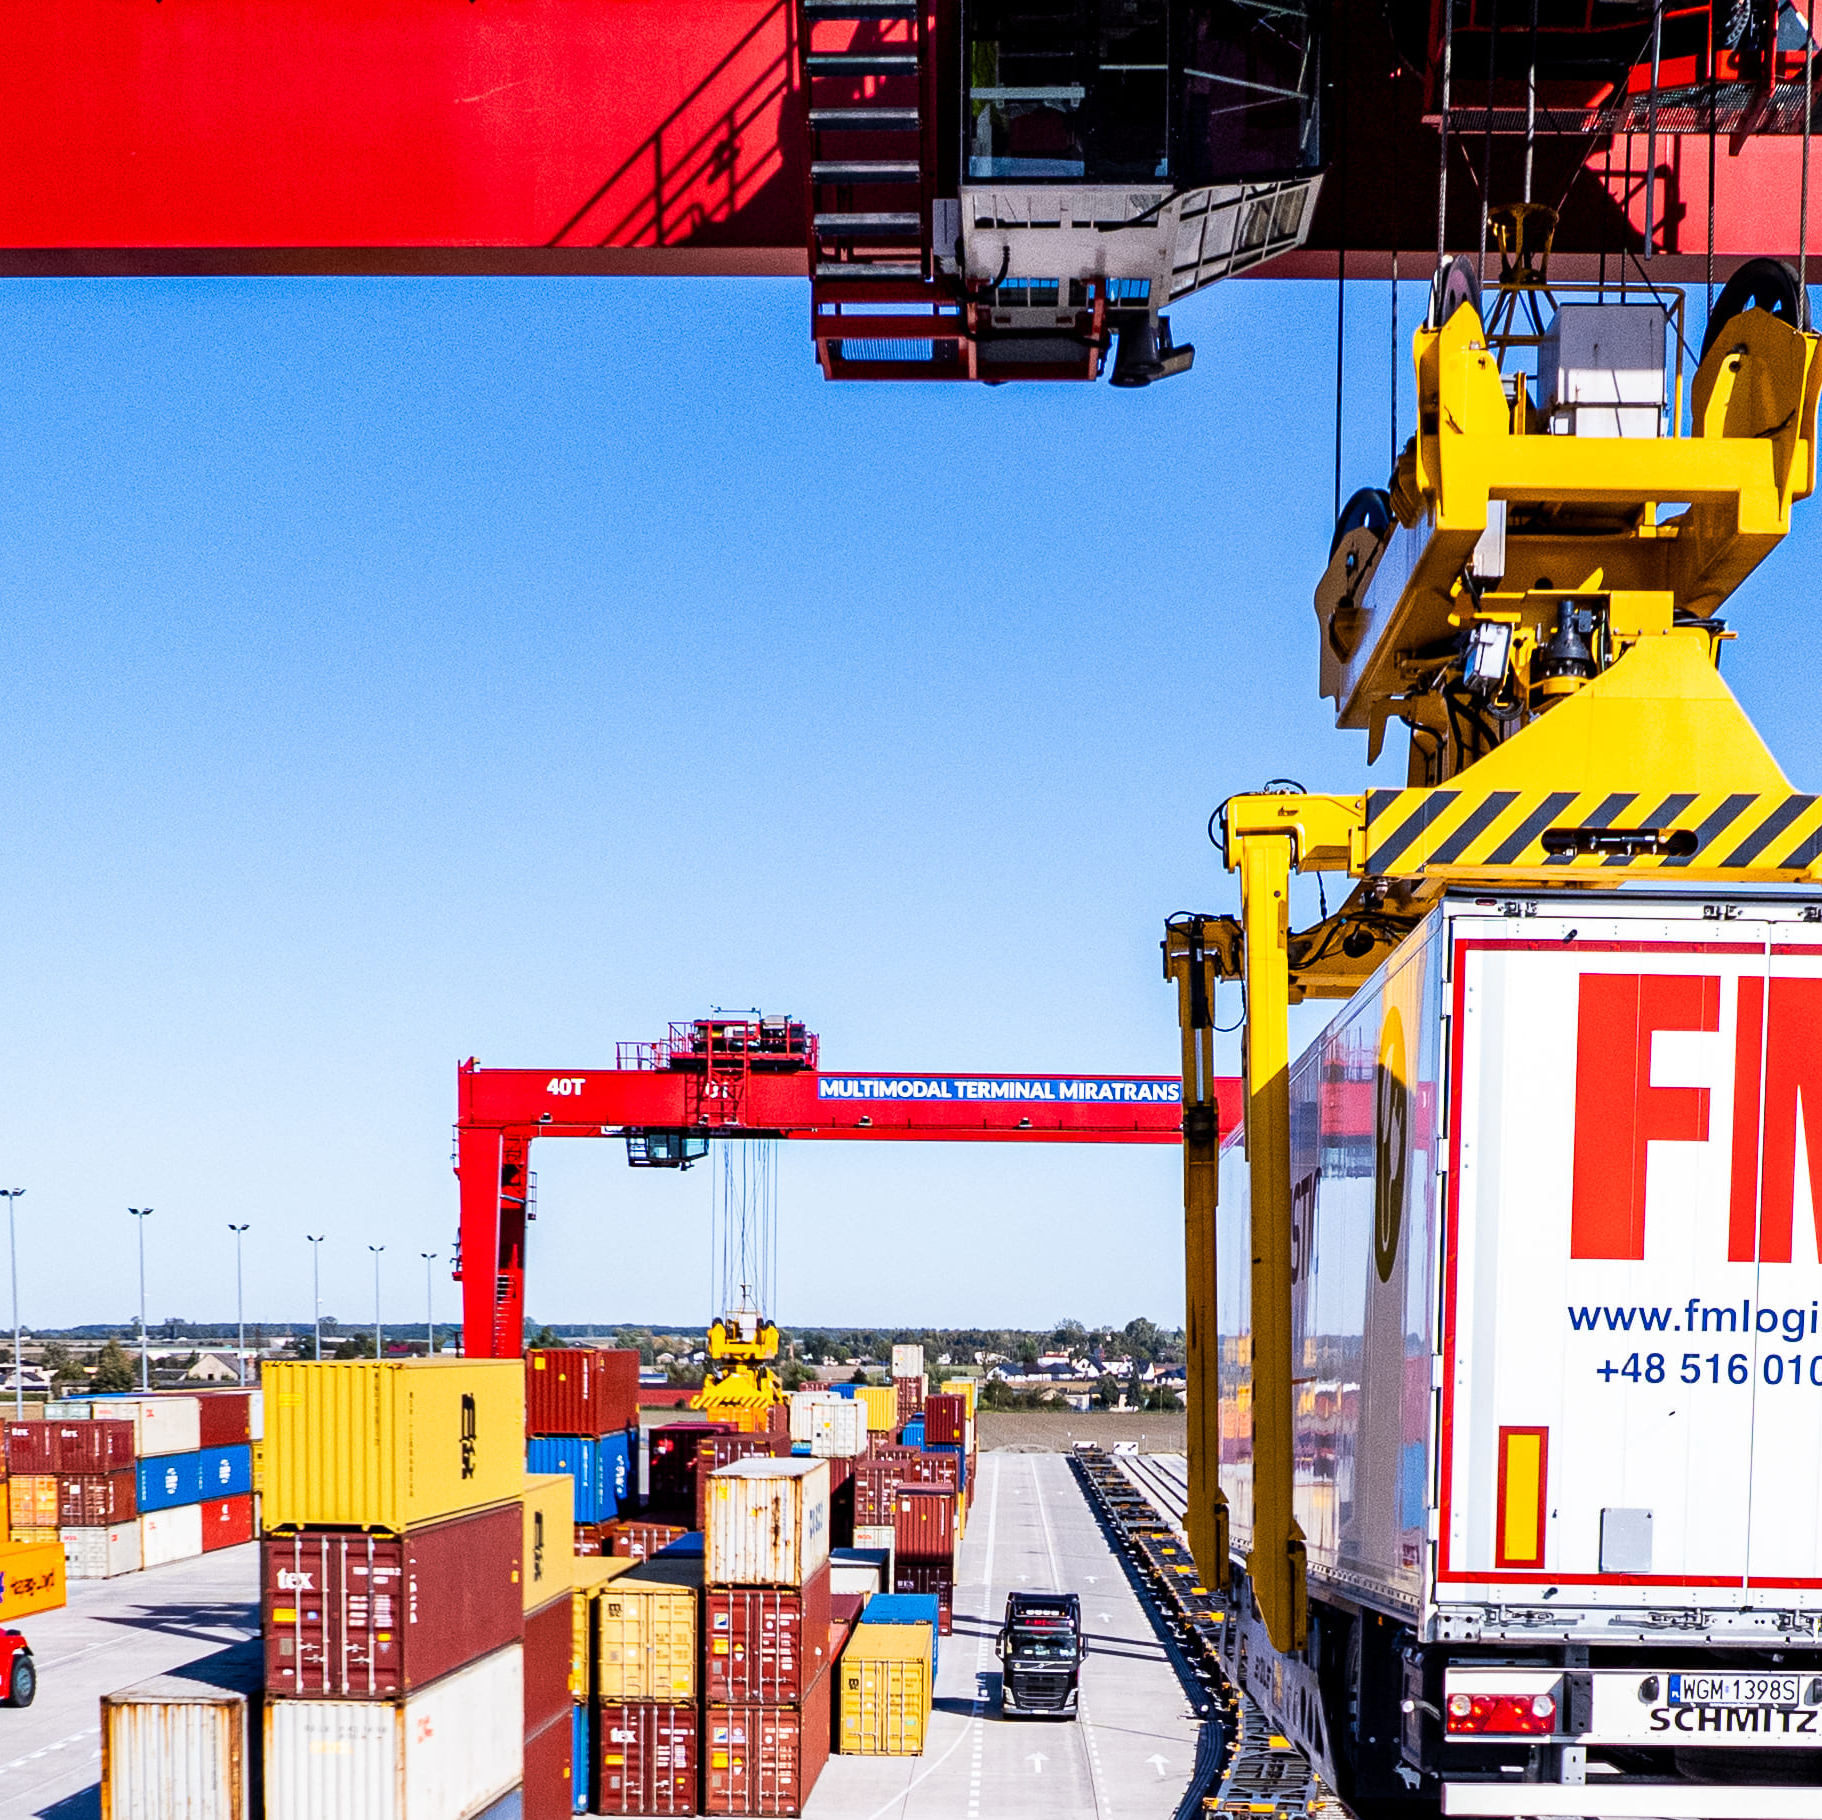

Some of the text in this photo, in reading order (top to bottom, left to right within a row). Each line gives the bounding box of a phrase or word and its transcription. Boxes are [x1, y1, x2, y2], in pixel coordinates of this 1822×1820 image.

[546, 1078, 586, 1096] 40T
[820, 1079, 1180, 1101] MULTIMODAL TERMINAL MIRATRANS
[1595, 1352, 1666, 1384] +48
[1680, 1353, 1749, 1386] 516
[276, 1567, 315, 1590] tex
[1683, 1679, 1723, 1700] WGM
[1733, 1679, 1795, 1701] 1398S
[1650, 1707, 1818, 1733] SCHMITZ
